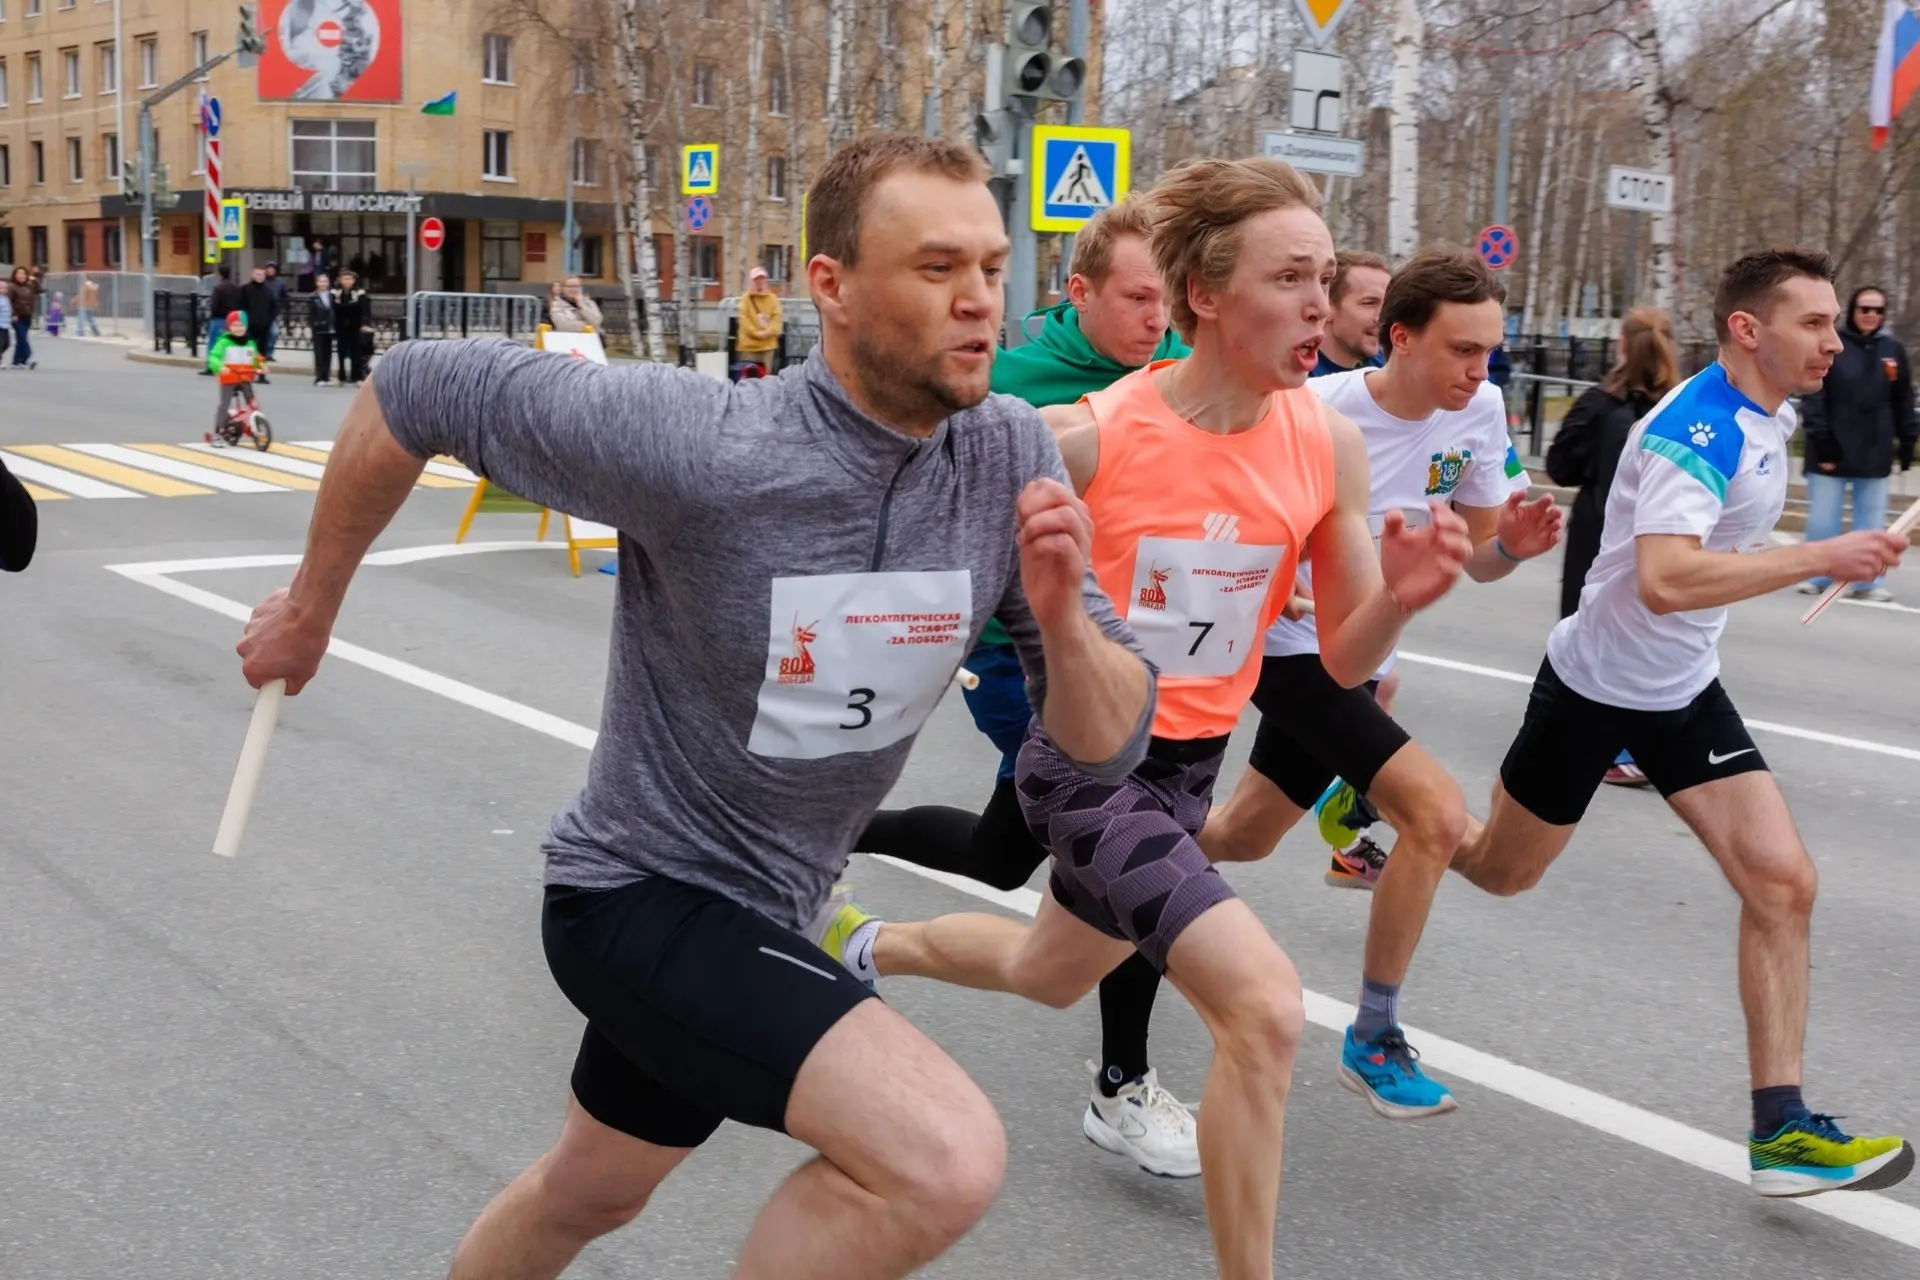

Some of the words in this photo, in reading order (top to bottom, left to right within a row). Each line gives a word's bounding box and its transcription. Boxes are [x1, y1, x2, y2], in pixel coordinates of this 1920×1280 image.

[231, 186, 304, 210] ОЕННЫЙ
[312, 194, 421, 213] КОМИССАРИ
[1618, 175, 1667, 203] СТОП
[1140, 588, 1156, 601] 80
[845, 612, 961, 624] ЛЕГКОАТЛЕТИЧЕСКАЯ
[907, 623, 960, 633] ЭСТАФЕТА
[1188, 621, 1215, 656] 7
[779, 657, 801, 673] 80
[839, 687, 876, 730] 3
